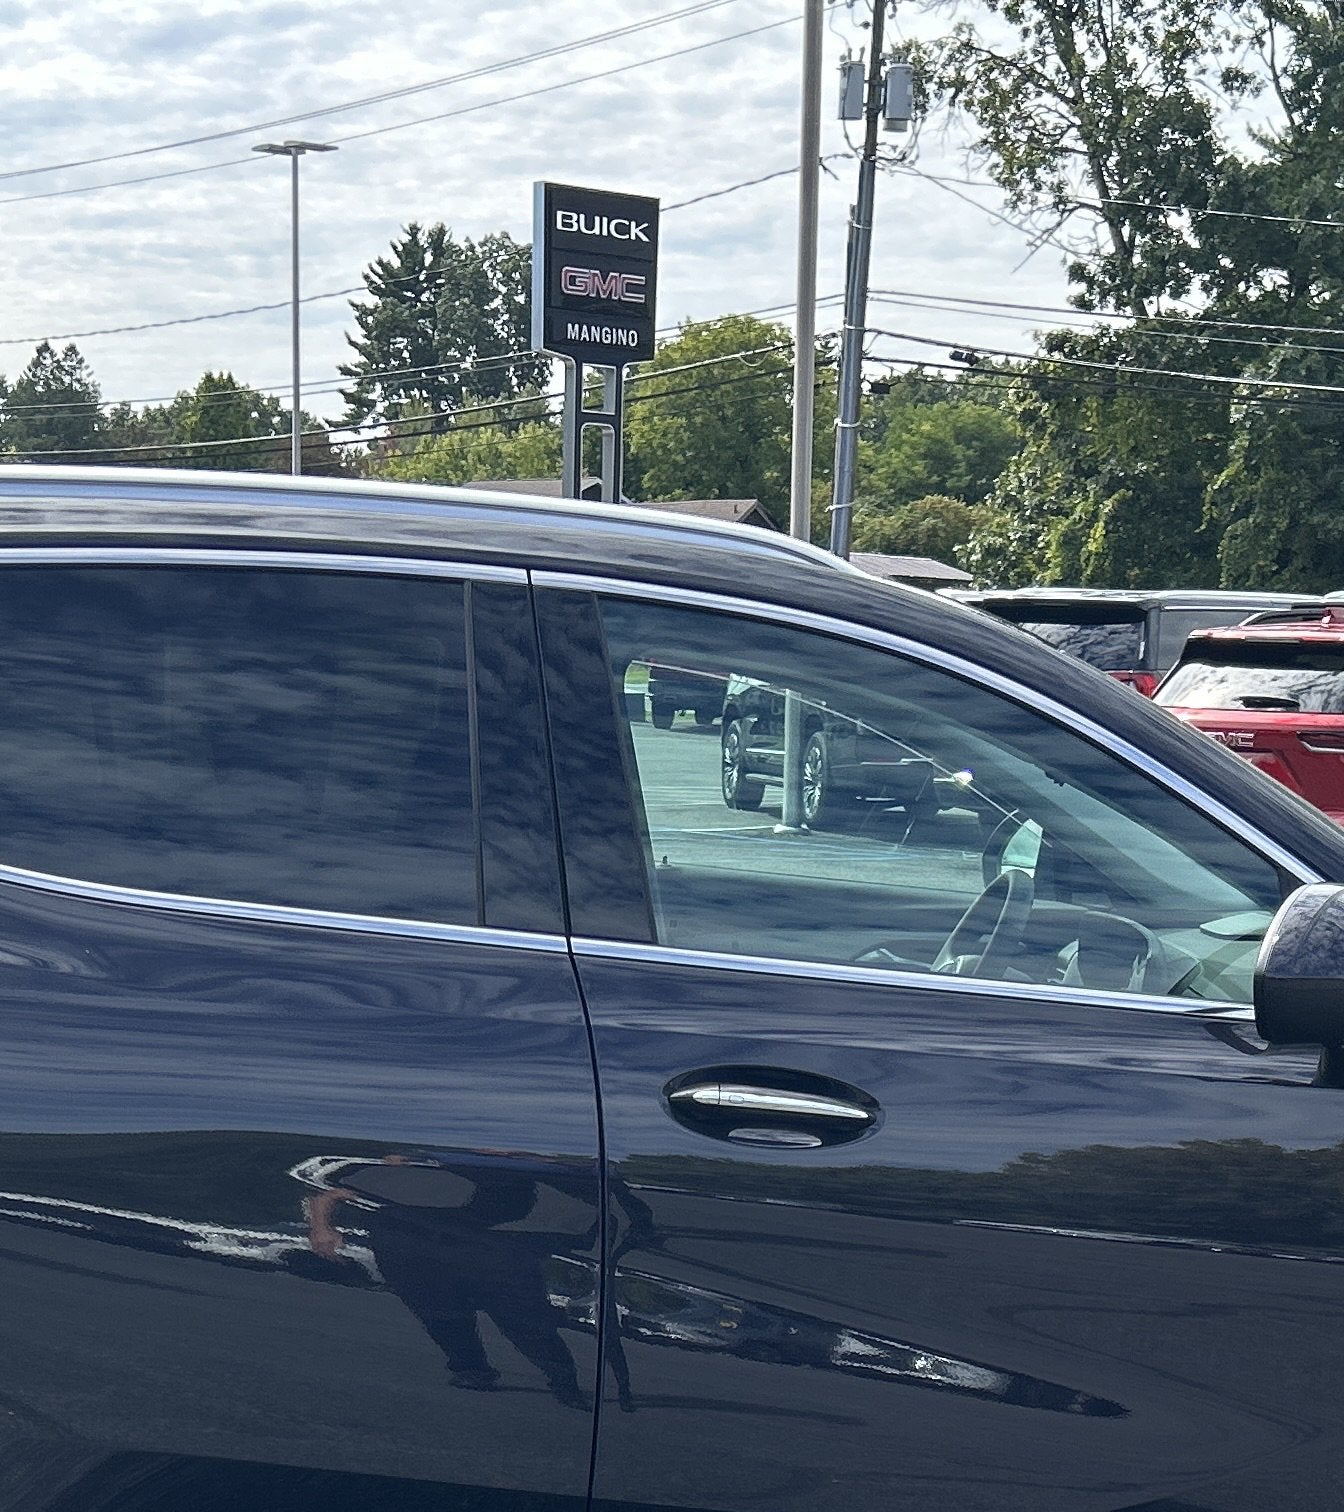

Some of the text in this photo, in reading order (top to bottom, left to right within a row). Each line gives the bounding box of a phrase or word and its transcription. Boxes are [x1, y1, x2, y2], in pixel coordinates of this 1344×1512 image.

[556, 210, 650, 242] BUICK
[561, 266, 646, 304] GMC
[567, 322, 638, 347] MANGINO
[1203, 731, 1255, 748] MC
